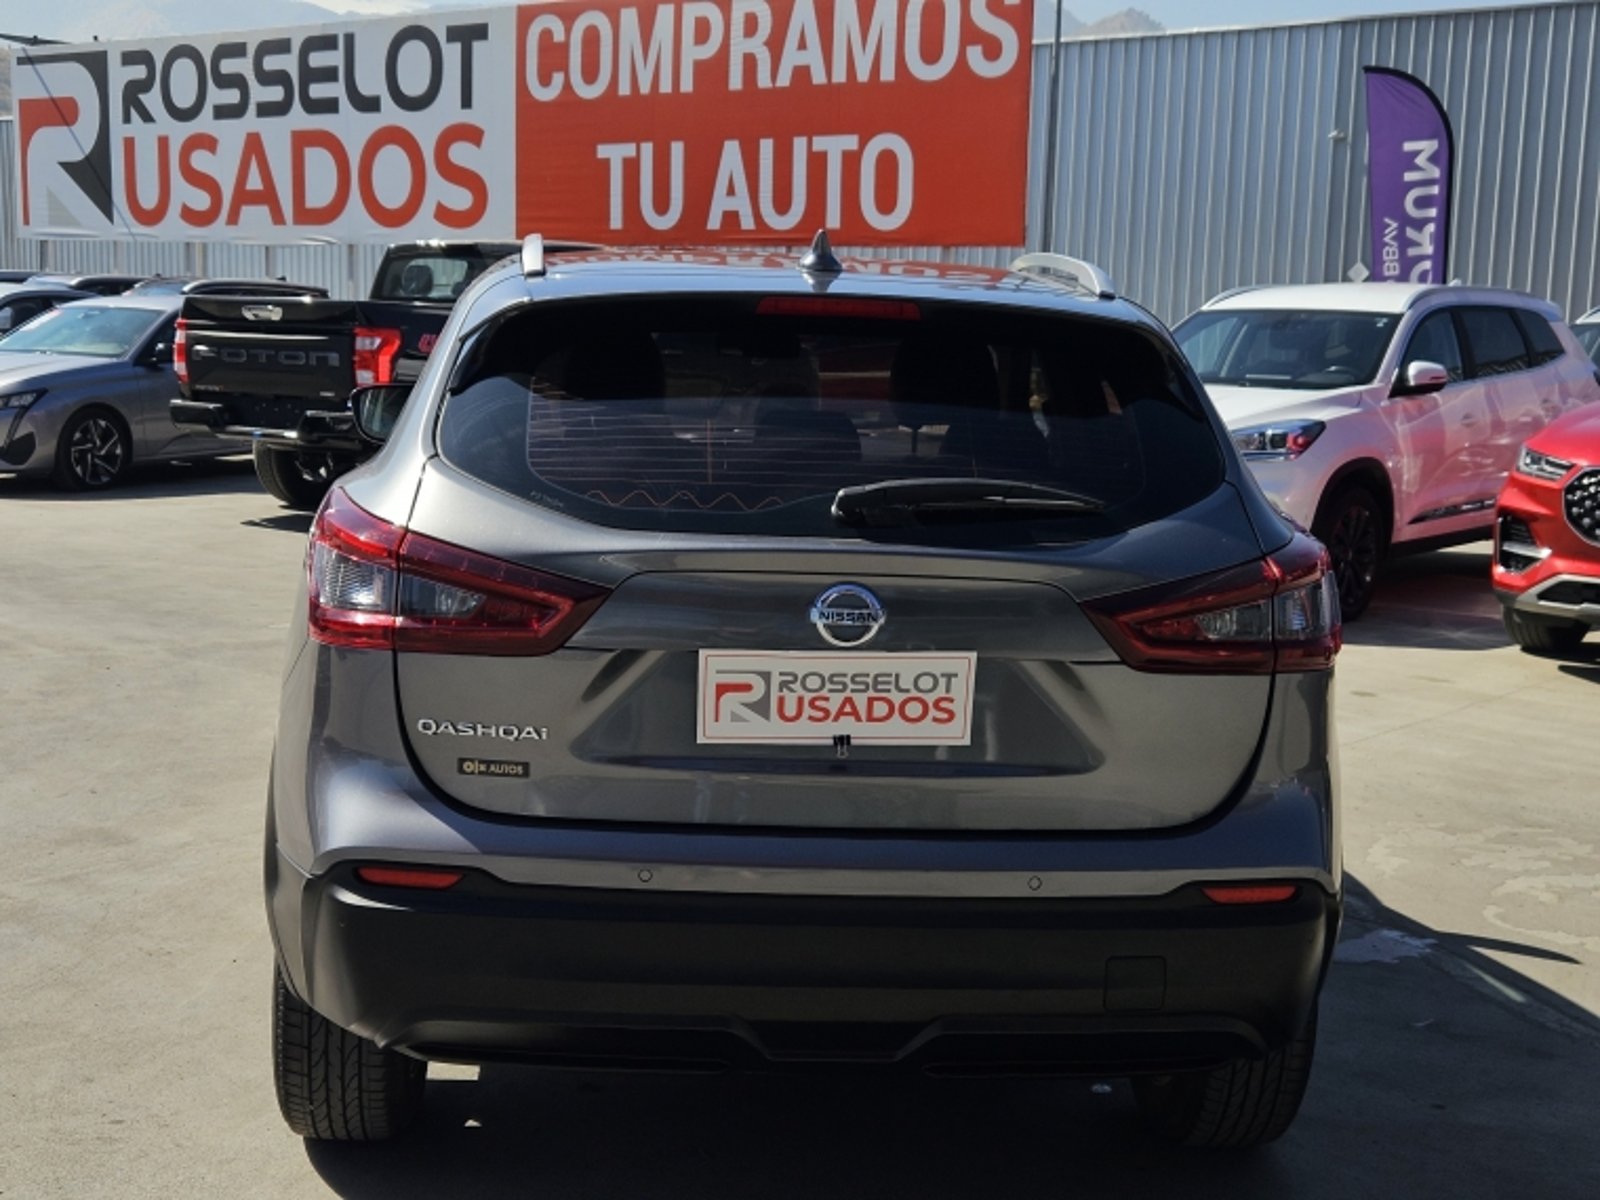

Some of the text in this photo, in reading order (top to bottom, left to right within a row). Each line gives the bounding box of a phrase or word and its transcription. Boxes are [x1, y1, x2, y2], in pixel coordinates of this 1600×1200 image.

[121, 22, 489, 125] ROSSELOT
[525, 0, 1021, 101] COMPRAMOS
[122, 122, 490, 229] USADOS
[596, 132, 914, 231] TU AUTO
[819, 610, 878, 622] NISSAN
[776, 695, 957, 723] USADOS
[778, 671, 958, 694] ROSSELOT
[488, 763, 524, 775] AUTOS
